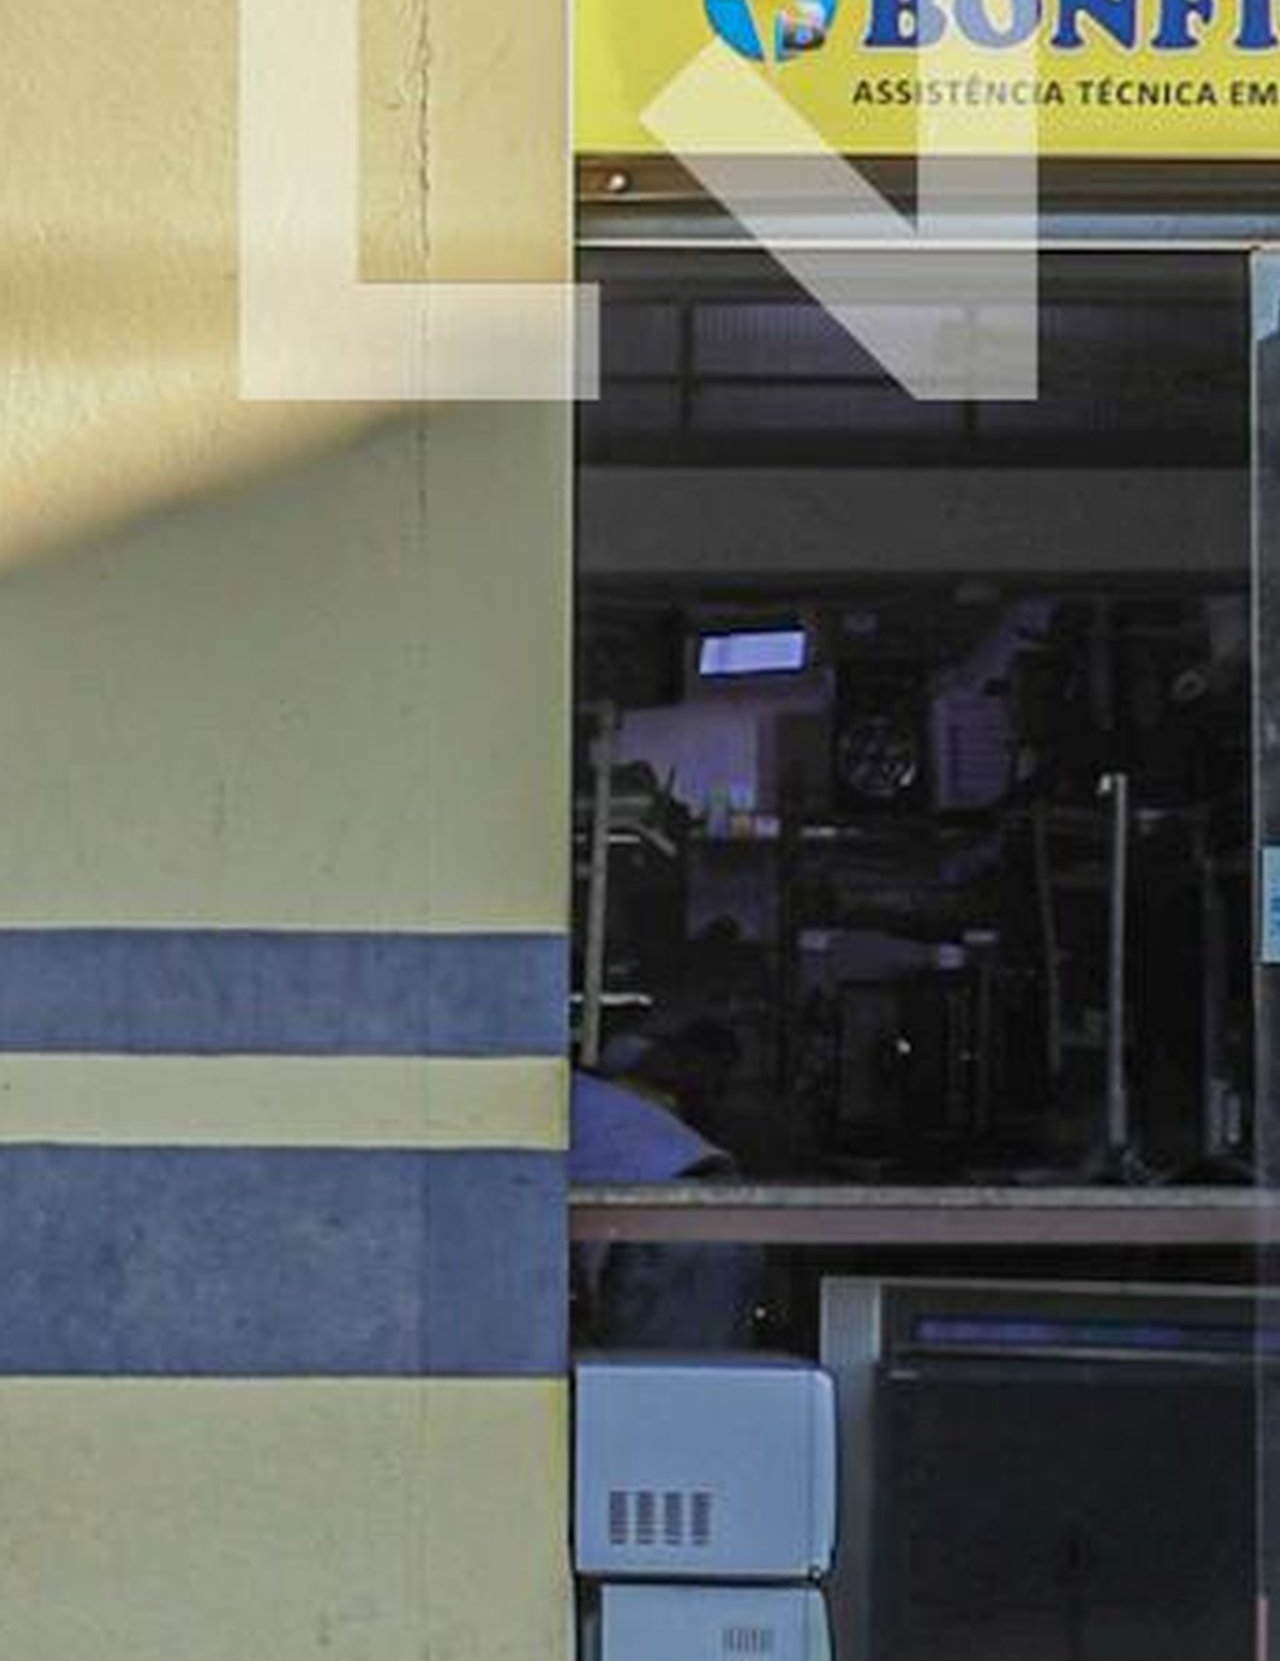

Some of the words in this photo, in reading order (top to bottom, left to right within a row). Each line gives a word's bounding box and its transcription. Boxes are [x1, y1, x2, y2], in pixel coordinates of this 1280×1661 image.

[853, 79, 1065, 107] ASSISTÊNCIA
[1080, 78, 1218, 108] TÉCNICA
[1230, 81, 1280, 108] EM
